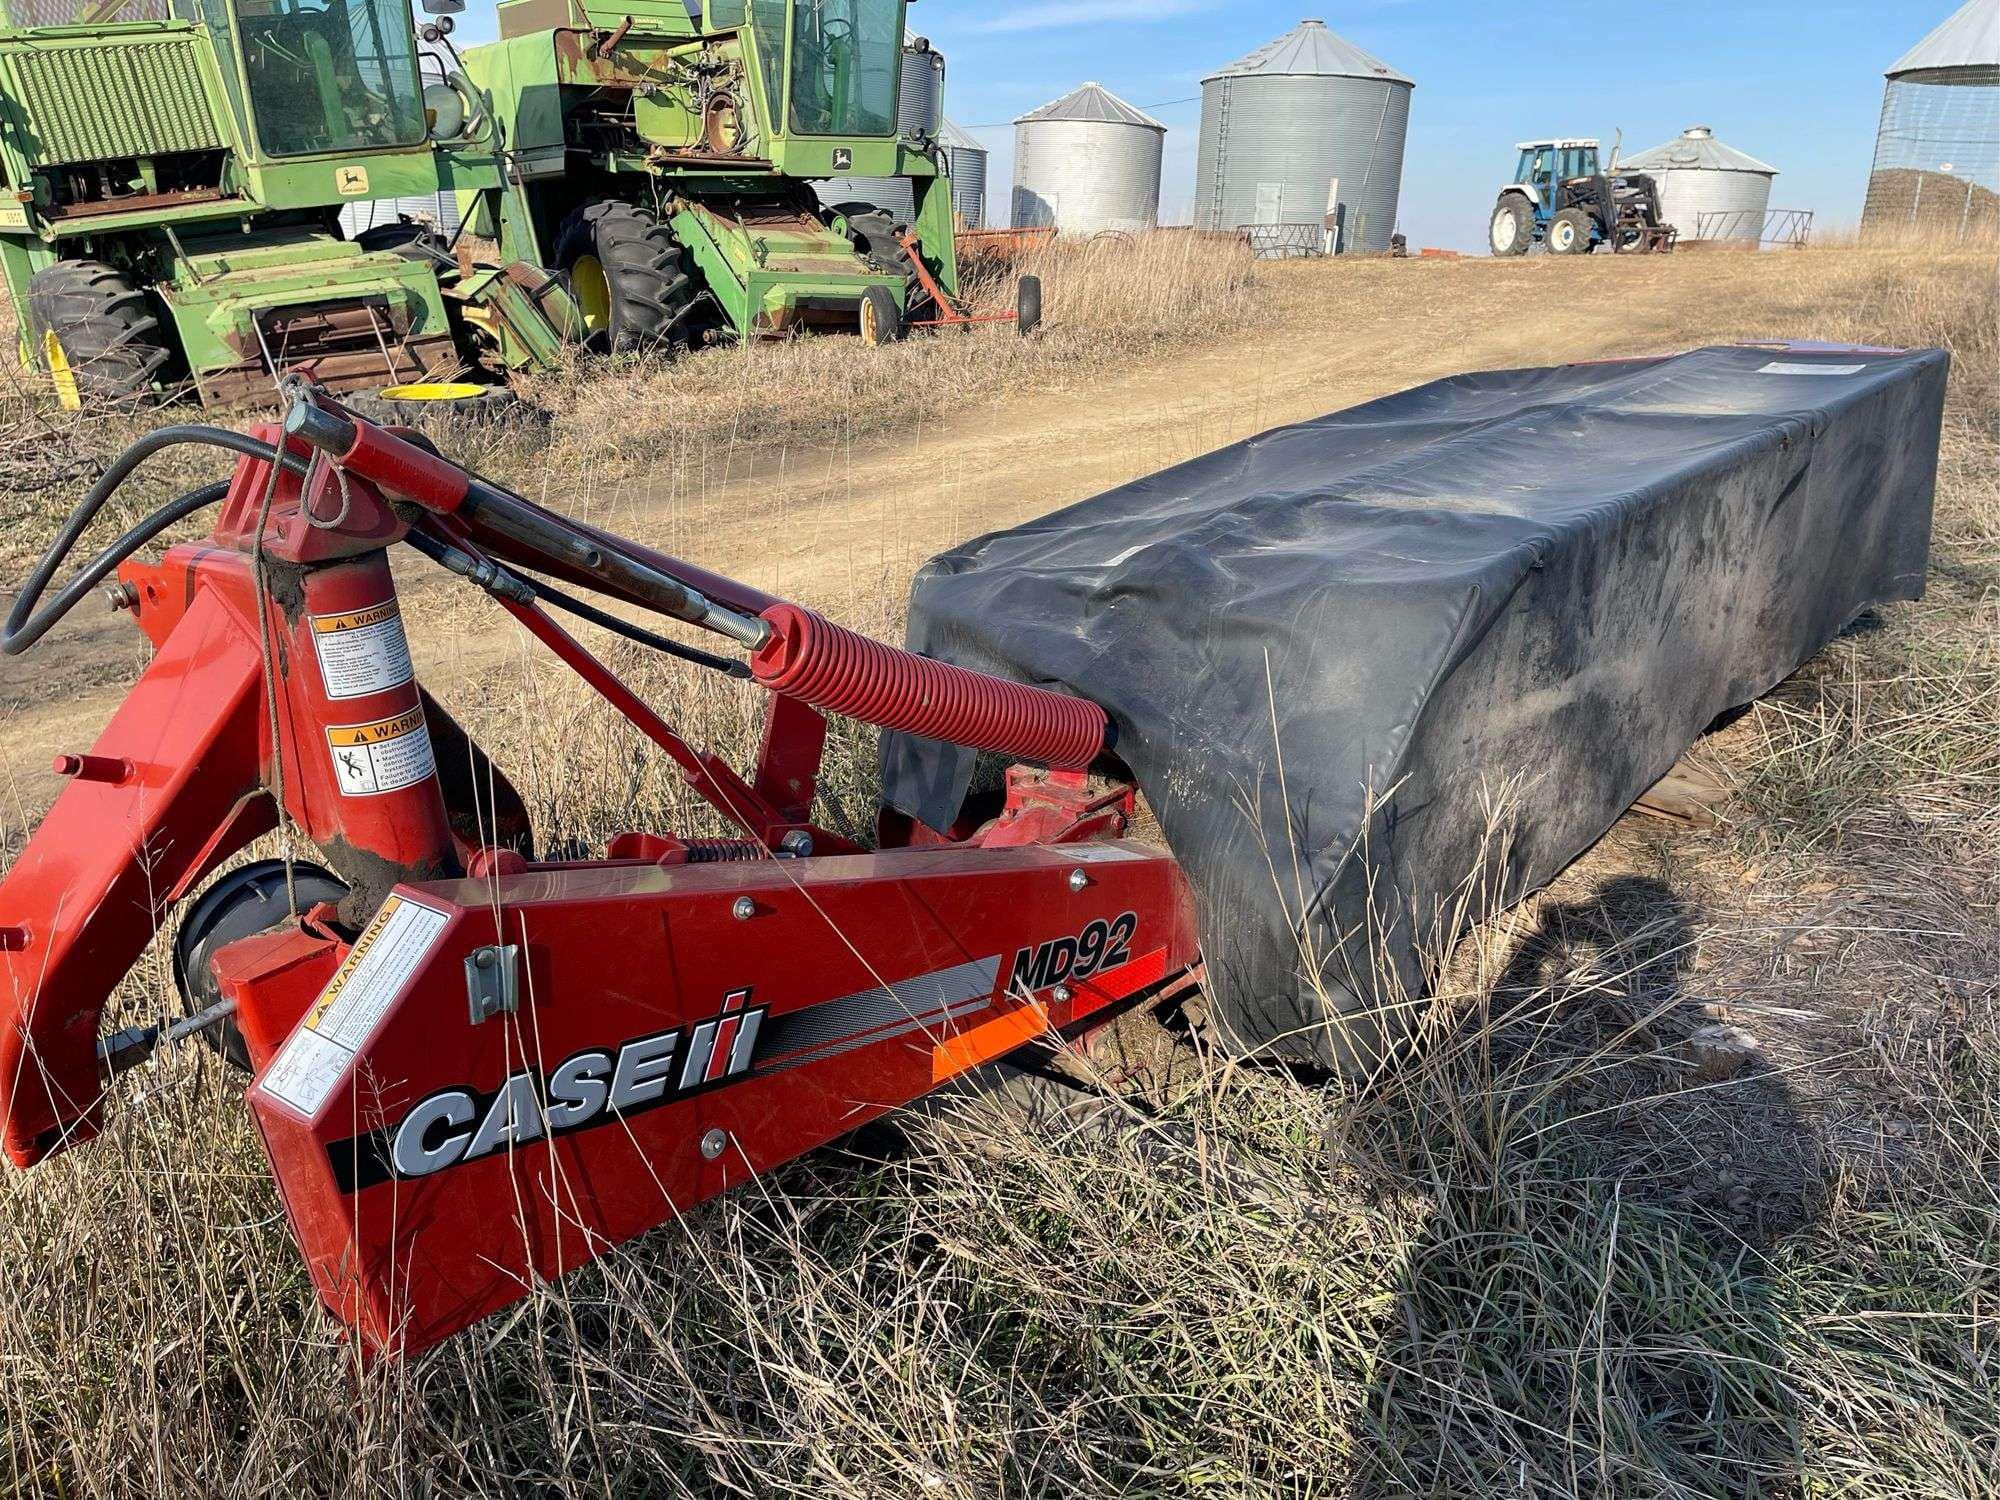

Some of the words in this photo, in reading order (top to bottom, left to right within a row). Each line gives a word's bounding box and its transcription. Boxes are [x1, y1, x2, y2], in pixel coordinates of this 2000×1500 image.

[374, 711, 423, 738] WARNIN
[329, 910, 392, 997] WARNING
[1005, 911, 1138, 1002] MD92
[393, 1031, 679, 1176] CASE
